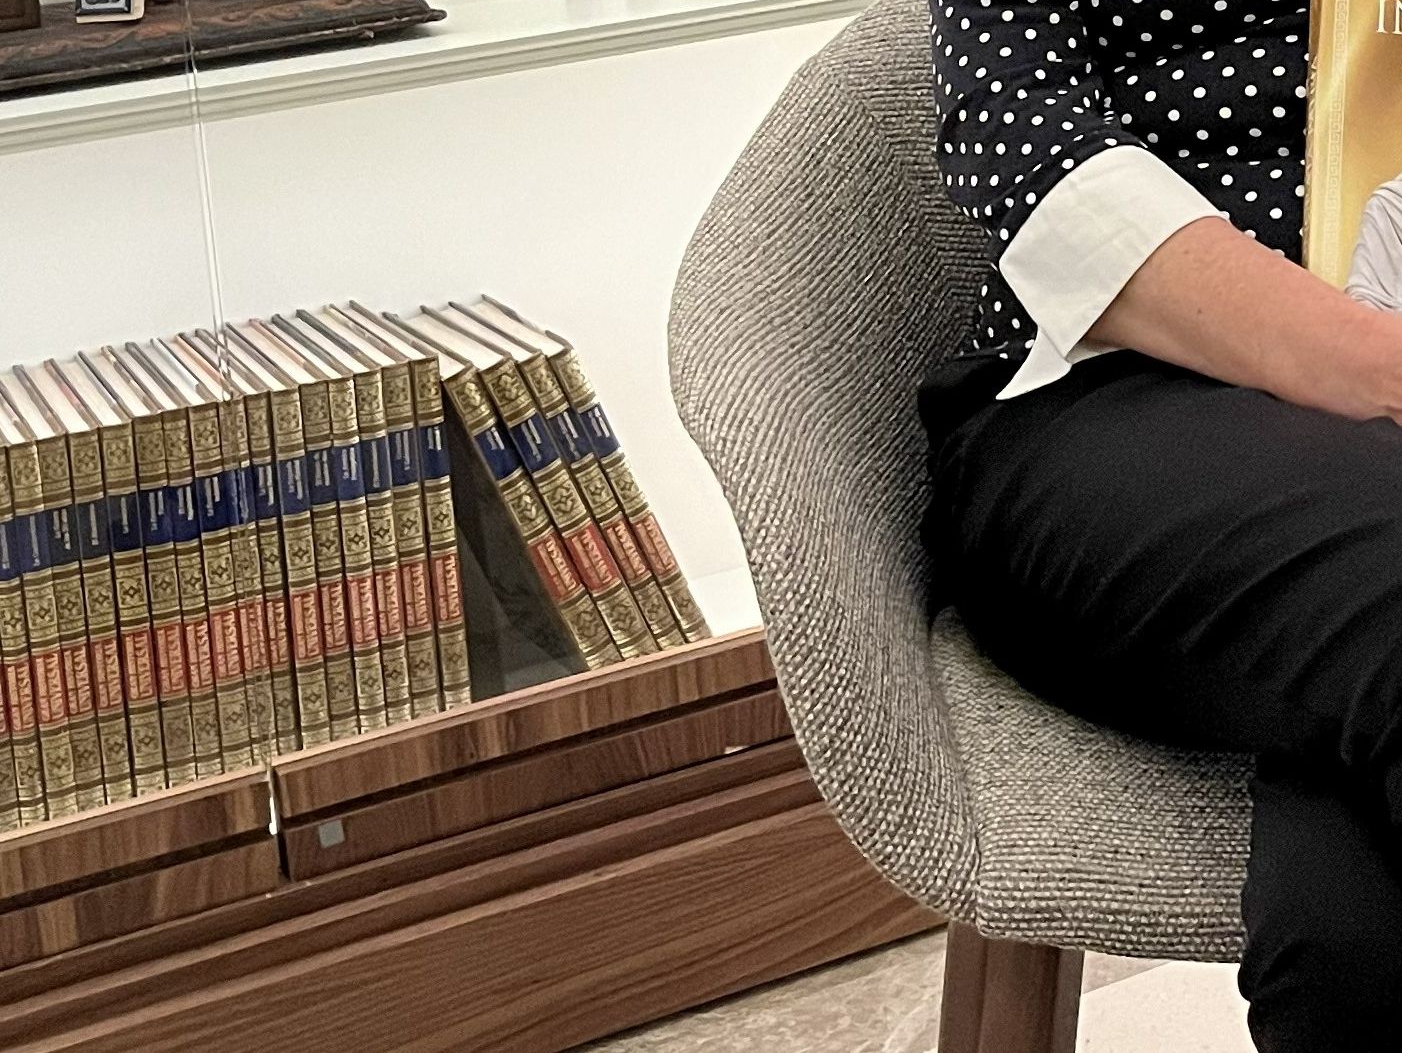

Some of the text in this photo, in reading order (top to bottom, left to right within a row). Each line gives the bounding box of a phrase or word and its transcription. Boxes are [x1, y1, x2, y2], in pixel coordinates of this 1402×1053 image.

[359, 579, 375, 639] UNIVERSAL
[446, 554, 461, 618] UNIVERSAL
[302, 592, 320, 655] UNIVERSAL
[18, 662, 34, 728] UNIVERSAL
[45, 653, 63, 720] UNIVERSAL
[76, 646, 92, 711] UNIVERSAL
[104, 639, 123, 706] UNIVERSAL
[135, 631, 152, 697] UNIVERSAL
